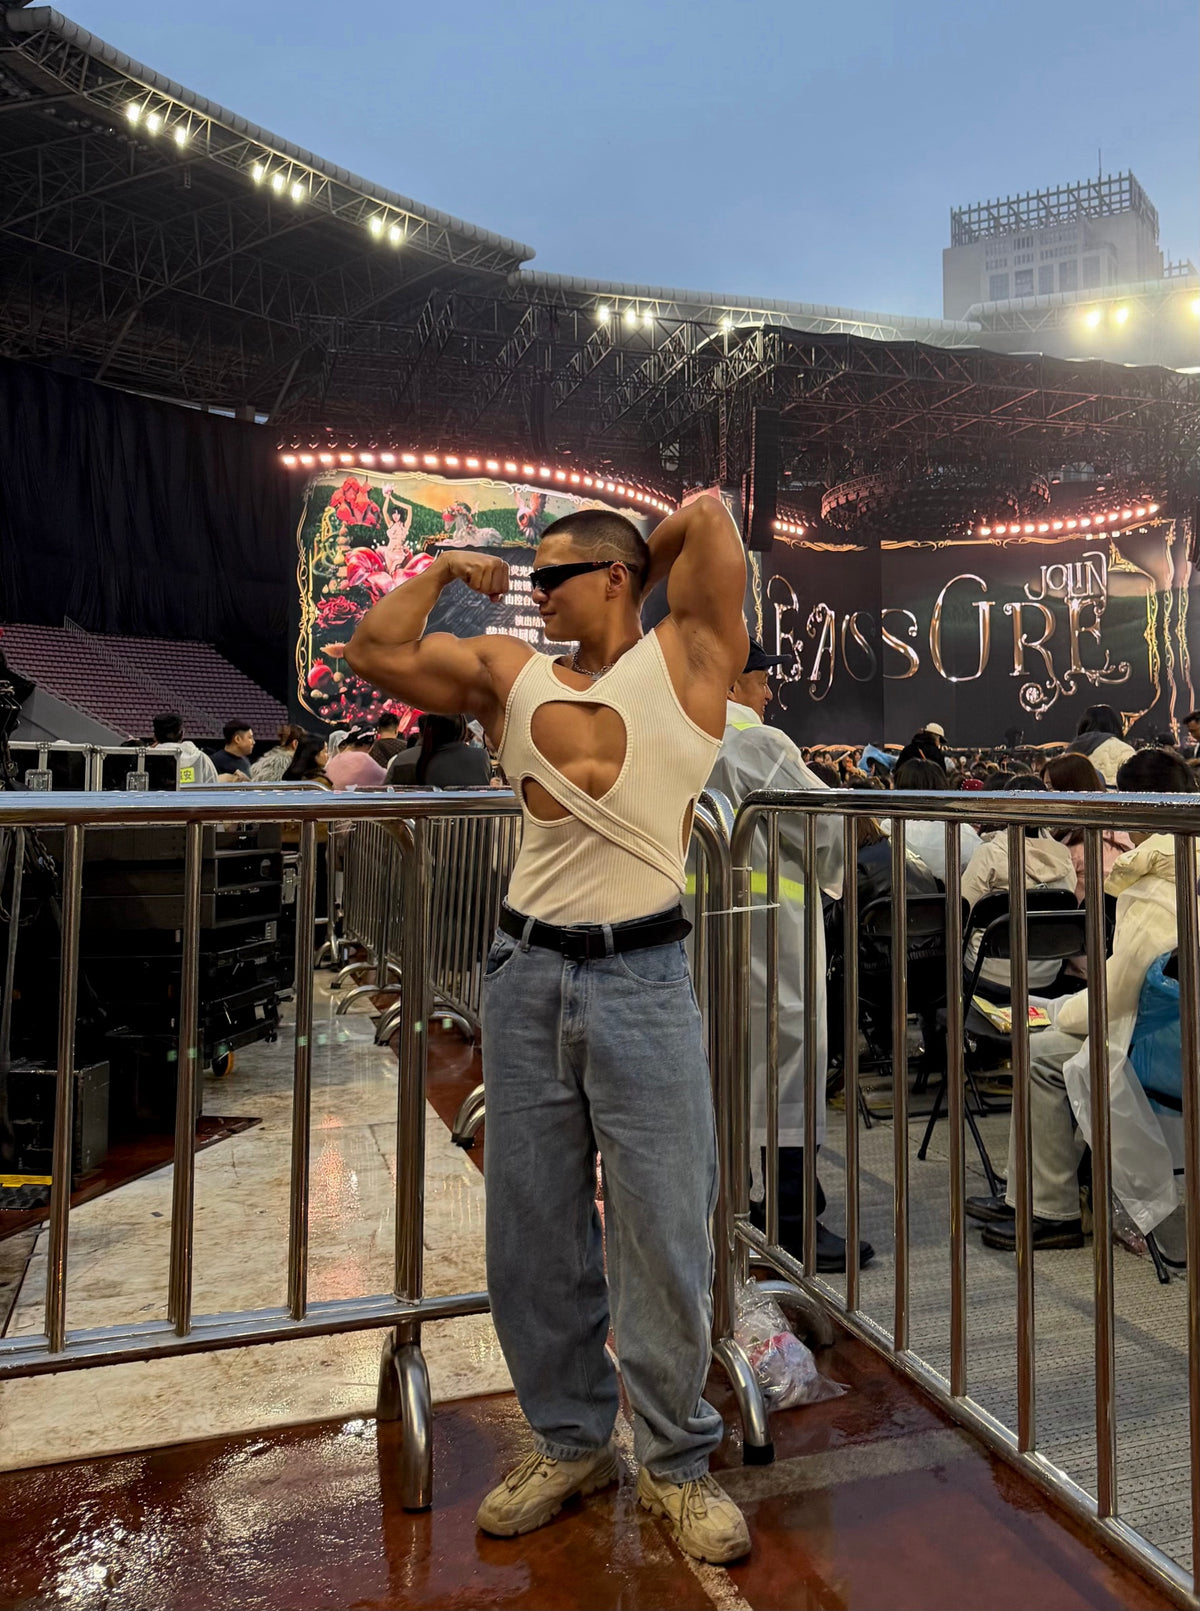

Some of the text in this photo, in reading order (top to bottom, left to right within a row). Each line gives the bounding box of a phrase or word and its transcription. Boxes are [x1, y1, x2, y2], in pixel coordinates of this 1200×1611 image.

[1023, 551, 1107, 605] JOLIN
[505, 594, 540, 606] 由控台
